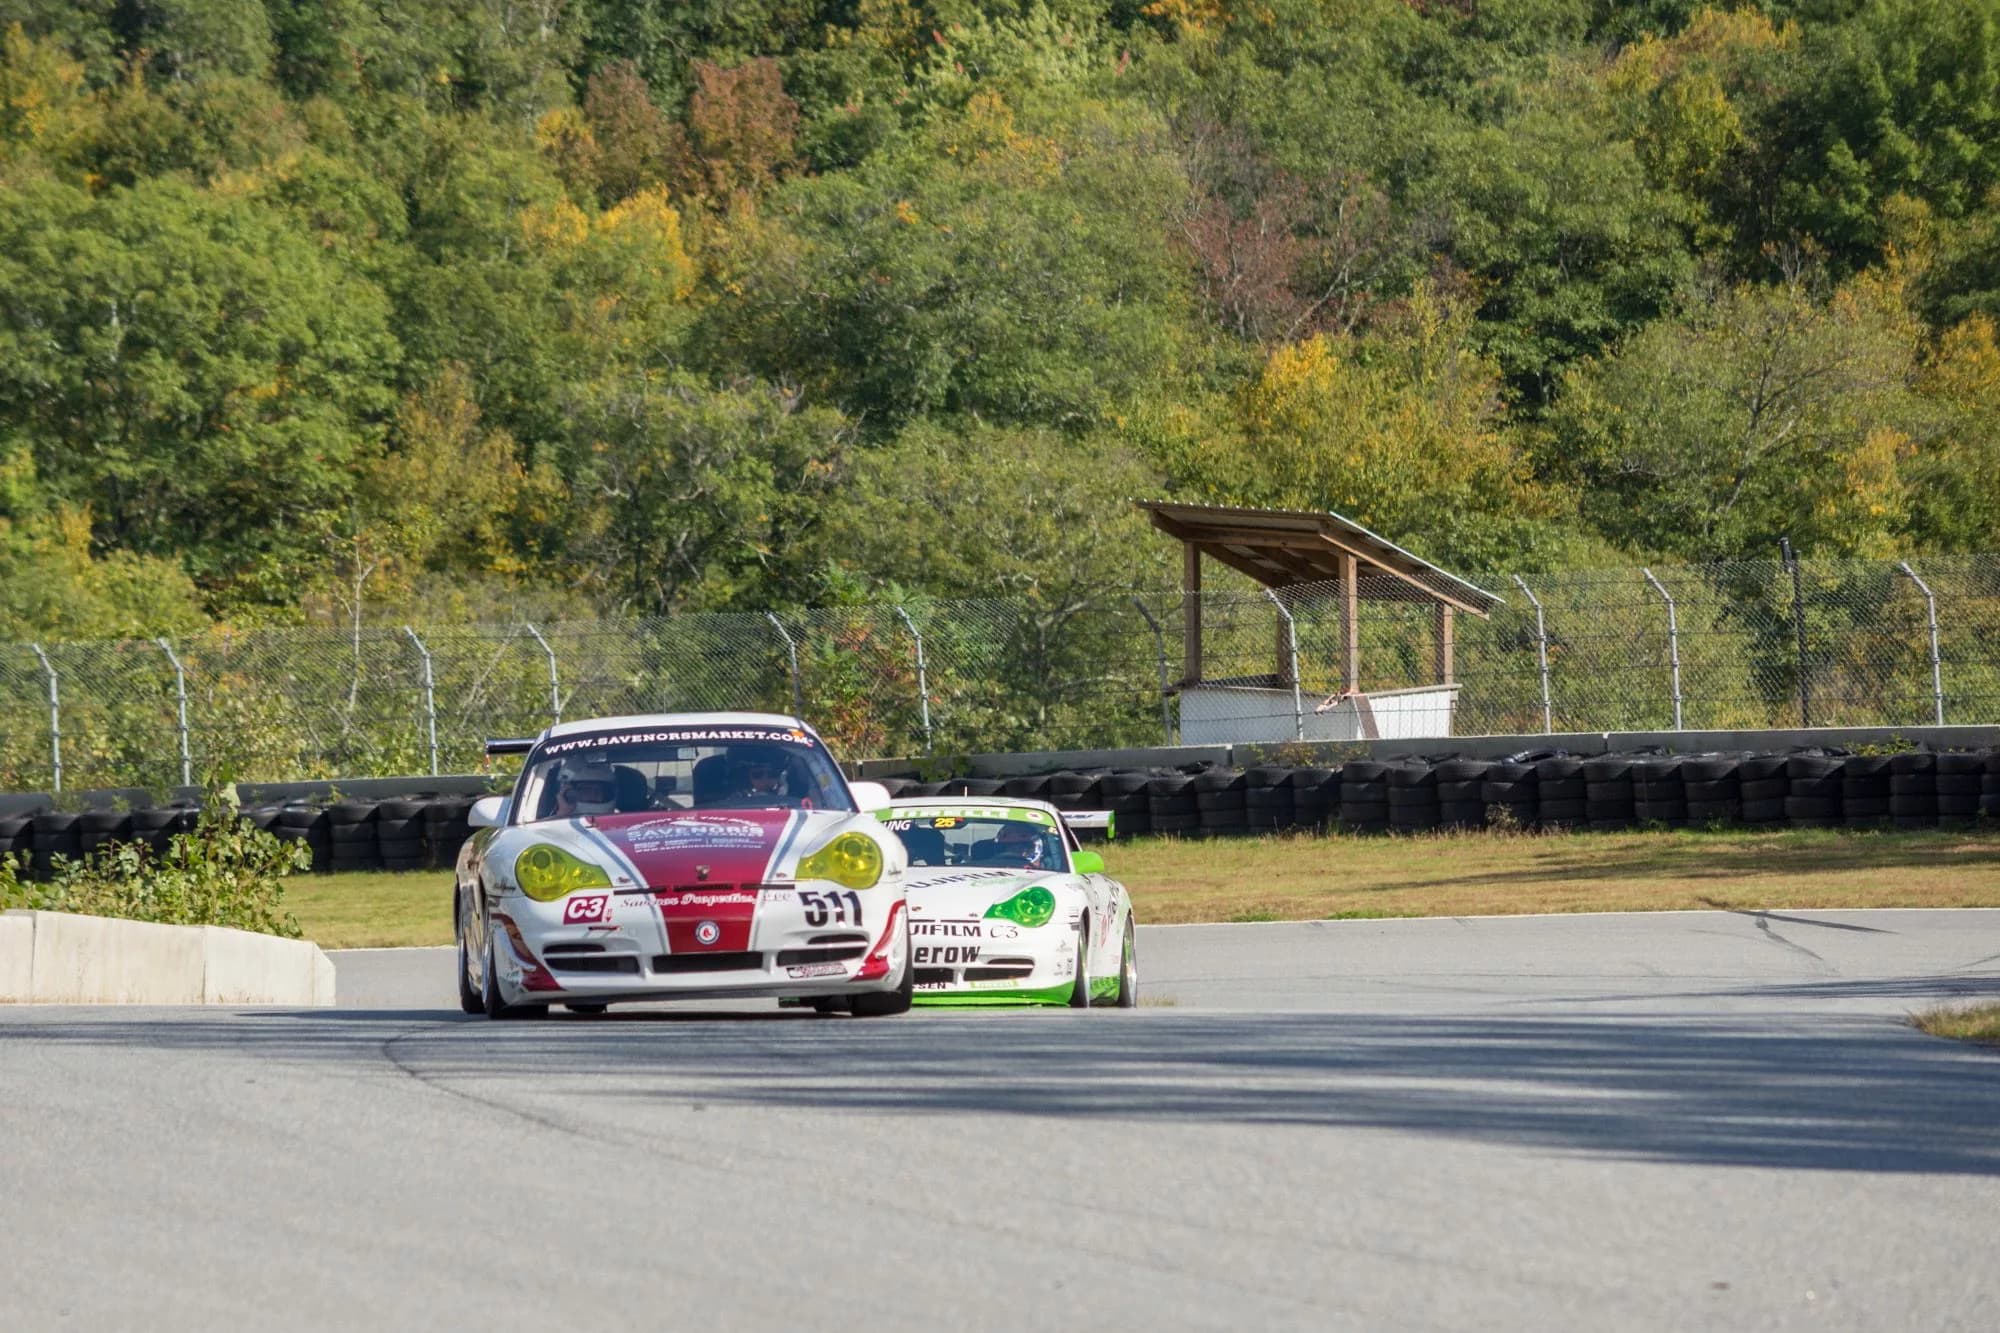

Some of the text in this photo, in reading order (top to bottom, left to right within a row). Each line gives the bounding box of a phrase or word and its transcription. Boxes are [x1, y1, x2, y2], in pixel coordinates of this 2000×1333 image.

[904, 870, 1014, 892] UJIFILM
[567, 896, 605, 919] C3
[798, 890, 863, 928] 511
[908, 923, 983, 938] JIFILM
